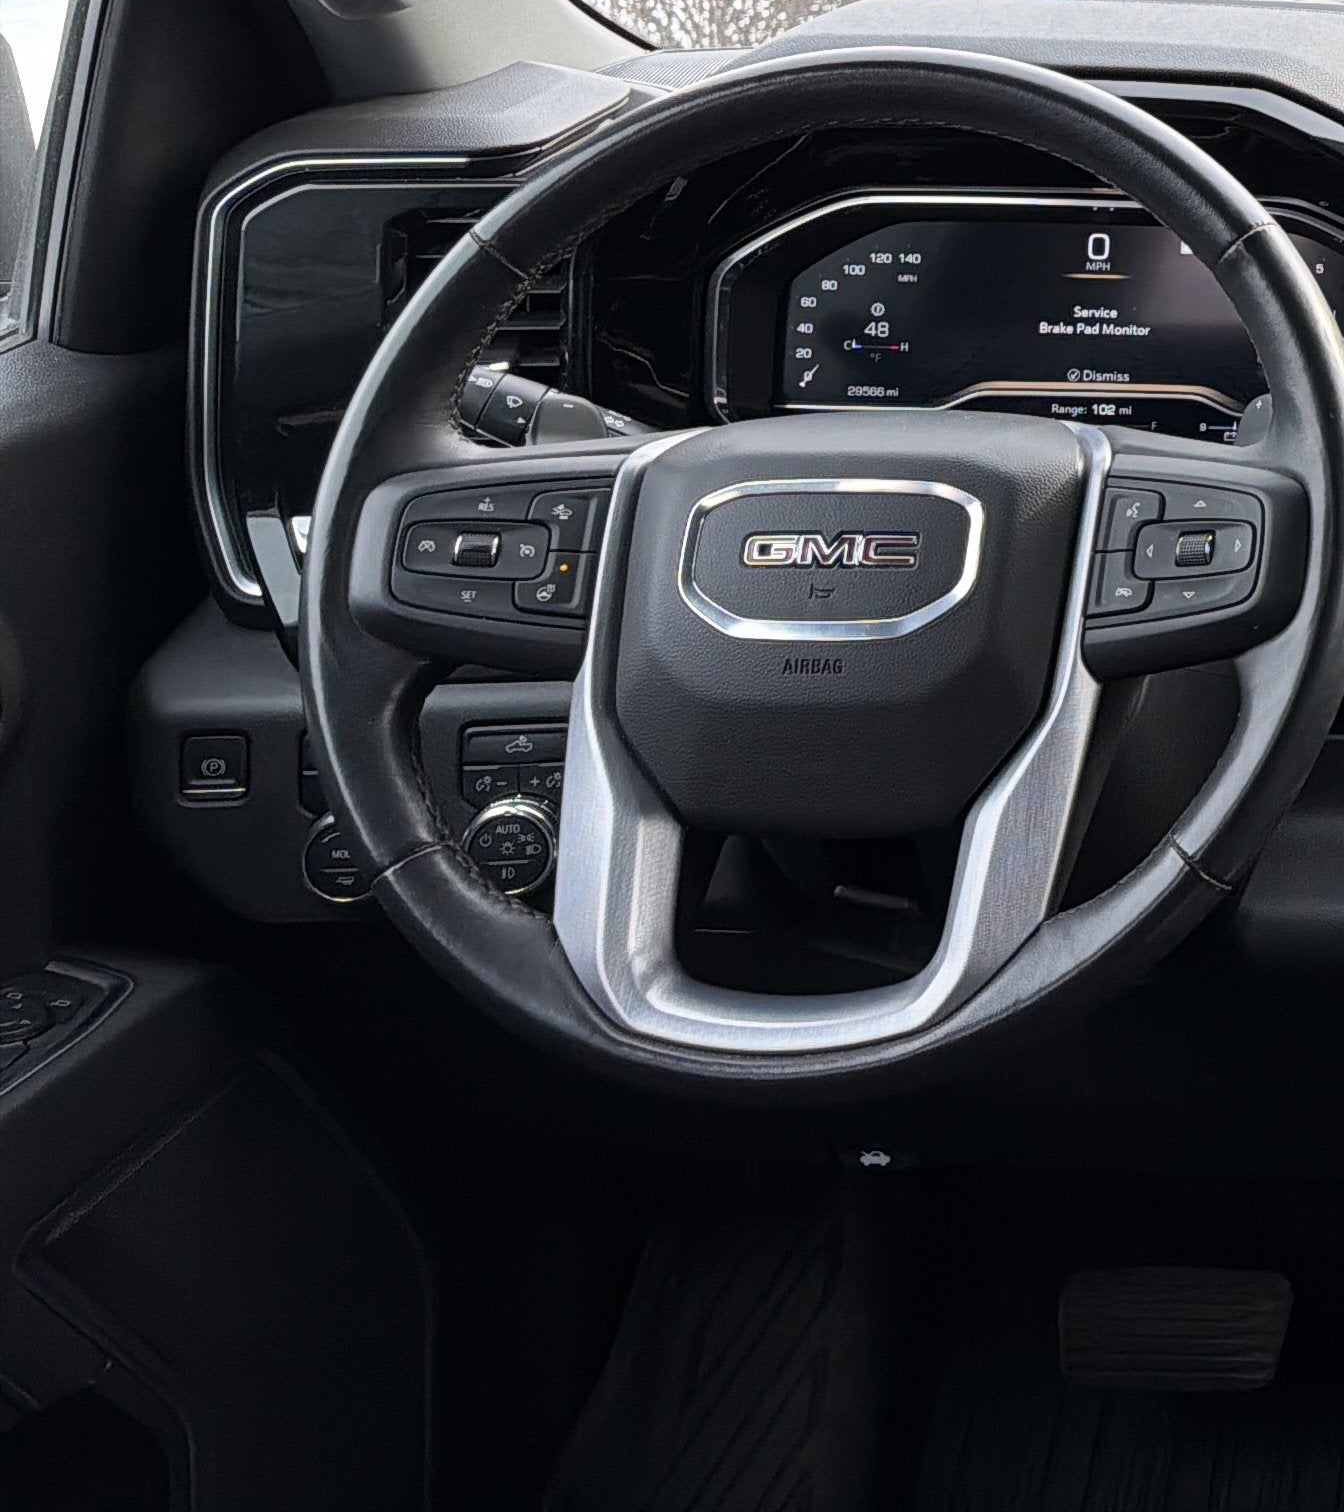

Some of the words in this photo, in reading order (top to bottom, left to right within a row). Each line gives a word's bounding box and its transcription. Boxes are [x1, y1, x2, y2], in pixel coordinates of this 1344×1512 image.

[1087, 233, 1111, 261] 0
[869, 253, 892, 264] 120
[898, 253, 922, 264] 140
[843, 264, 866, 275] 100
[1086, 261, 1111, 271] MPH
[1315, 264, 1324, 274] 5
[821, 280, 838, 291] 80
[800, 297, 817, 308] 60
[1073, 305, 1118, 319] Service
[796, 323, 814, 334] 40
[864, 322, 889, 338] 48
[1039, 322, 1074, 335] Brake
[1076, 323, 1099, 335] Pad
[1102, 323, 1151, 336] Monitor
[843, 340, 851, 351] C
[900, 342, 909, 352] H
[795, 348, 812, 359] 20
[1082, 370, 1130, 382] Dismiss
[886, 387, 899, 397] mi
[1051, 404, 1087, 417] Range:
[1091, 404, 1116, 416] 102
[1119, 405, 1132, 415] mi
[478, 503, 495, 512] RES
[743, 533, 918, 568] GMC
[460, 590, 477, 600] SET
[781, 657, 845, 675] AIRBAG
[495, 824, 520, 835] AUTO
